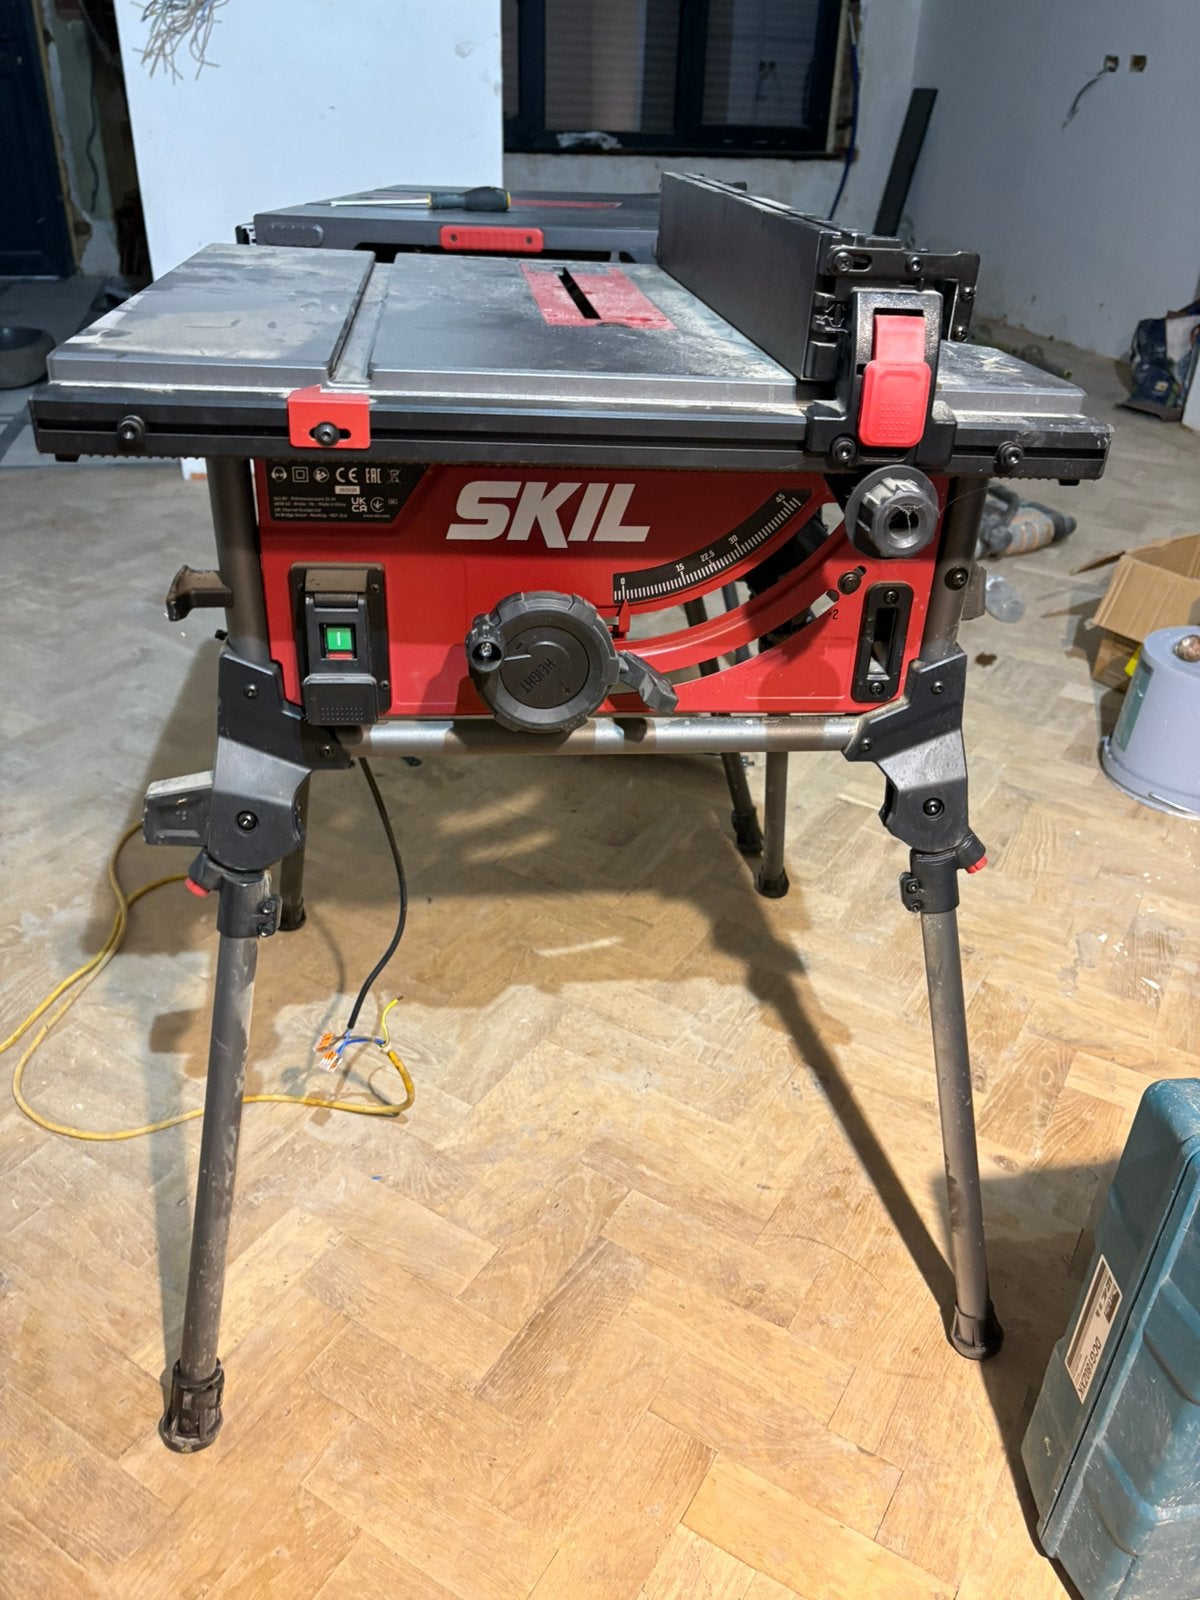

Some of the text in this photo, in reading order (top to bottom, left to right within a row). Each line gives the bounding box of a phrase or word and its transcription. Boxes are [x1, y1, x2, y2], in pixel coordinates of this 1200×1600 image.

[351, 497, 366, 505] UK
[775, 493, 785, 503] 45
[351, 505, 367, 513] CA
[446, 480, 650, 548] SKIL
[728, 534, 739, 545] 30
[700, 550, 715, 562] 22.5
[675, 563, 685, 572] 15
[620, 577, 626, 585] 0
[520, 658, 557, 695] HEIGHT
